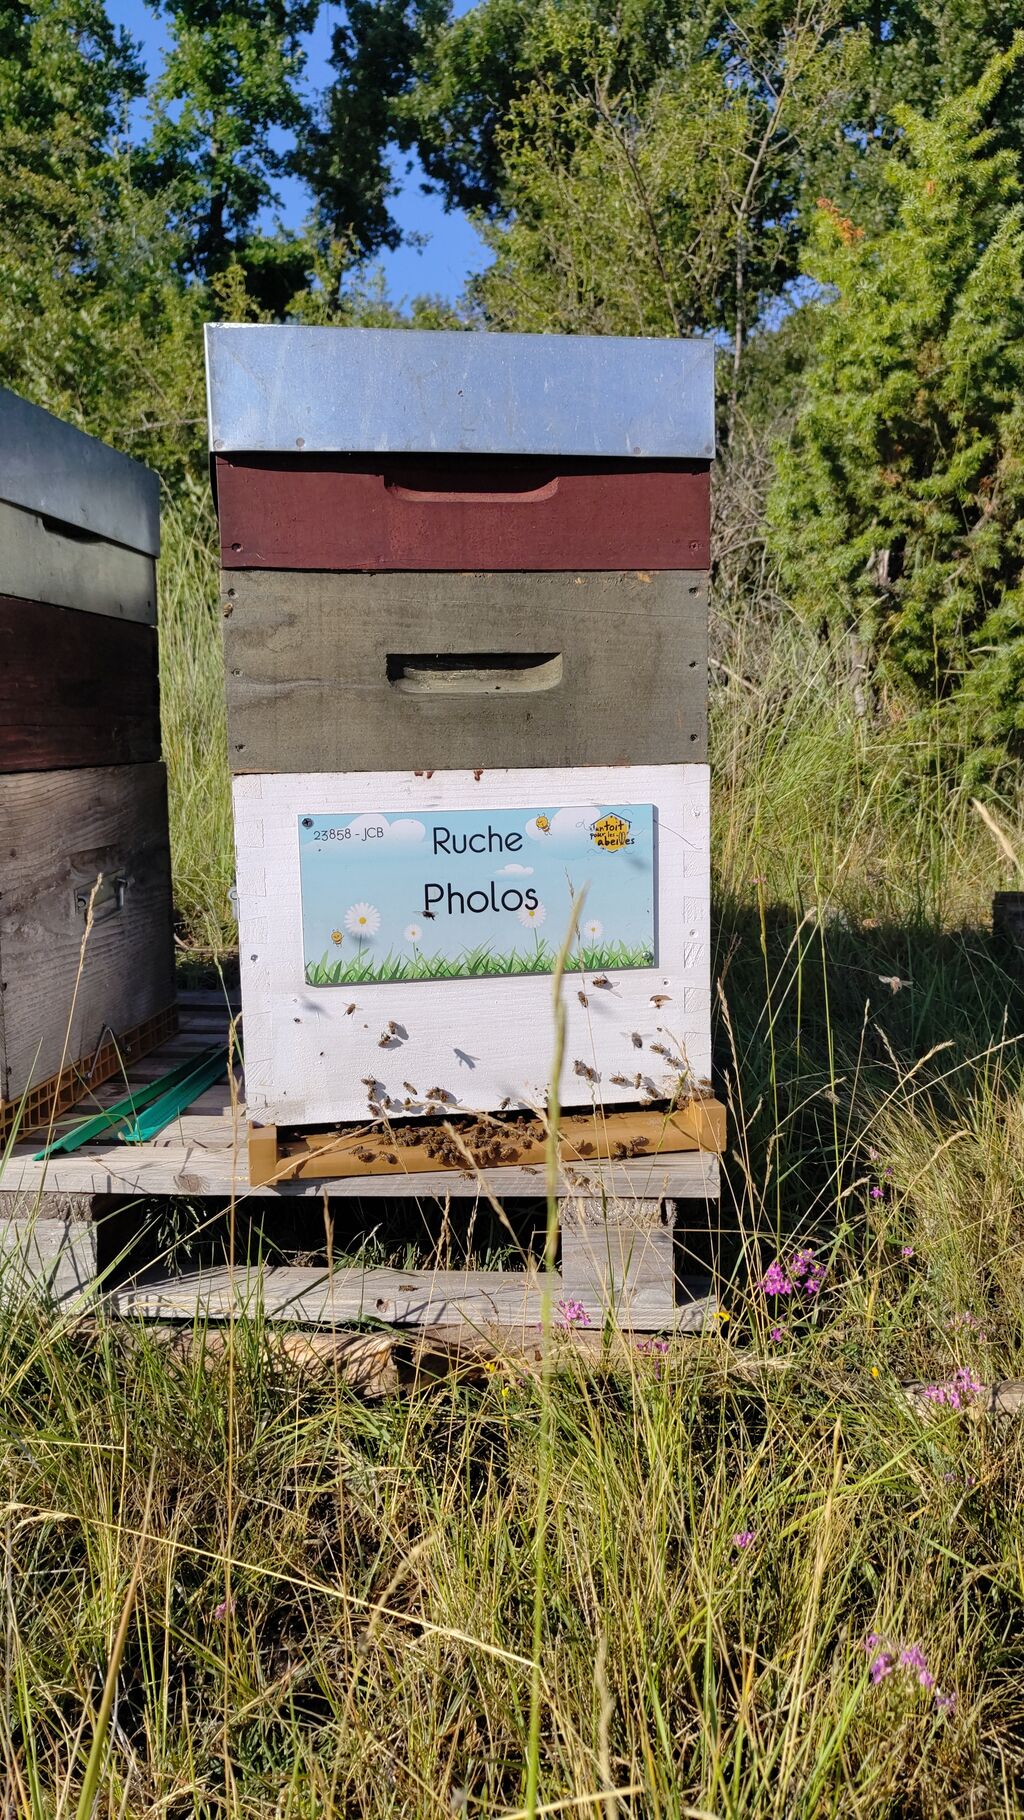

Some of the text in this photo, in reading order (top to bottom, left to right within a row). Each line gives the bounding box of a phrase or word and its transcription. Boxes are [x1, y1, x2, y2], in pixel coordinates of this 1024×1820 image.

[313, 828, 352, 842] 23858
[361, 826, 384, 842] JCB
[604, 820, 624, 831] toit
[433, 825, 523, 855] Ruche
[424, 881, 539, 915] Pholos
